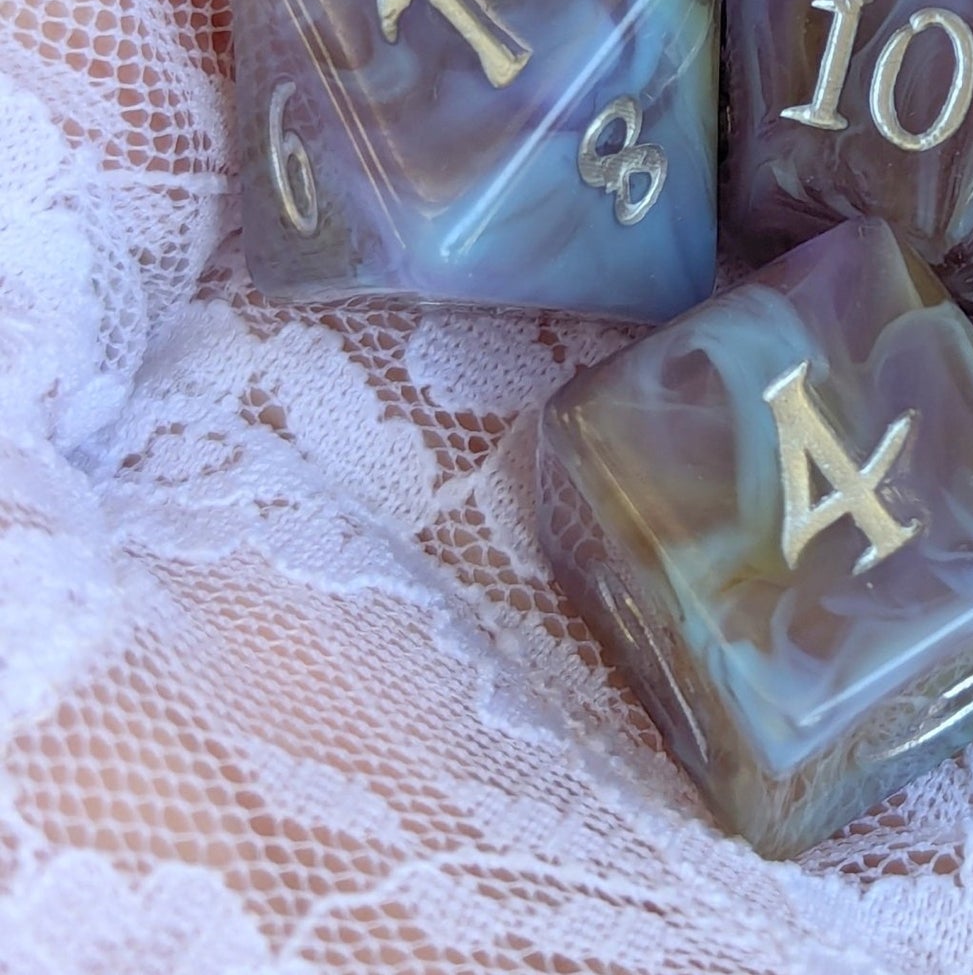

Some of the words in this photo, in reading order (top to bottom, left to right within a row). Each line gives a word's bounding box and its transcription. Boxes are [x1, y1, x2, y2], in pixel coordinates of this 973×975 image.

[269, 80, 320, 239] 6
[578, 94, 668, 226] 8
[762, 360, 924, 577] 4
